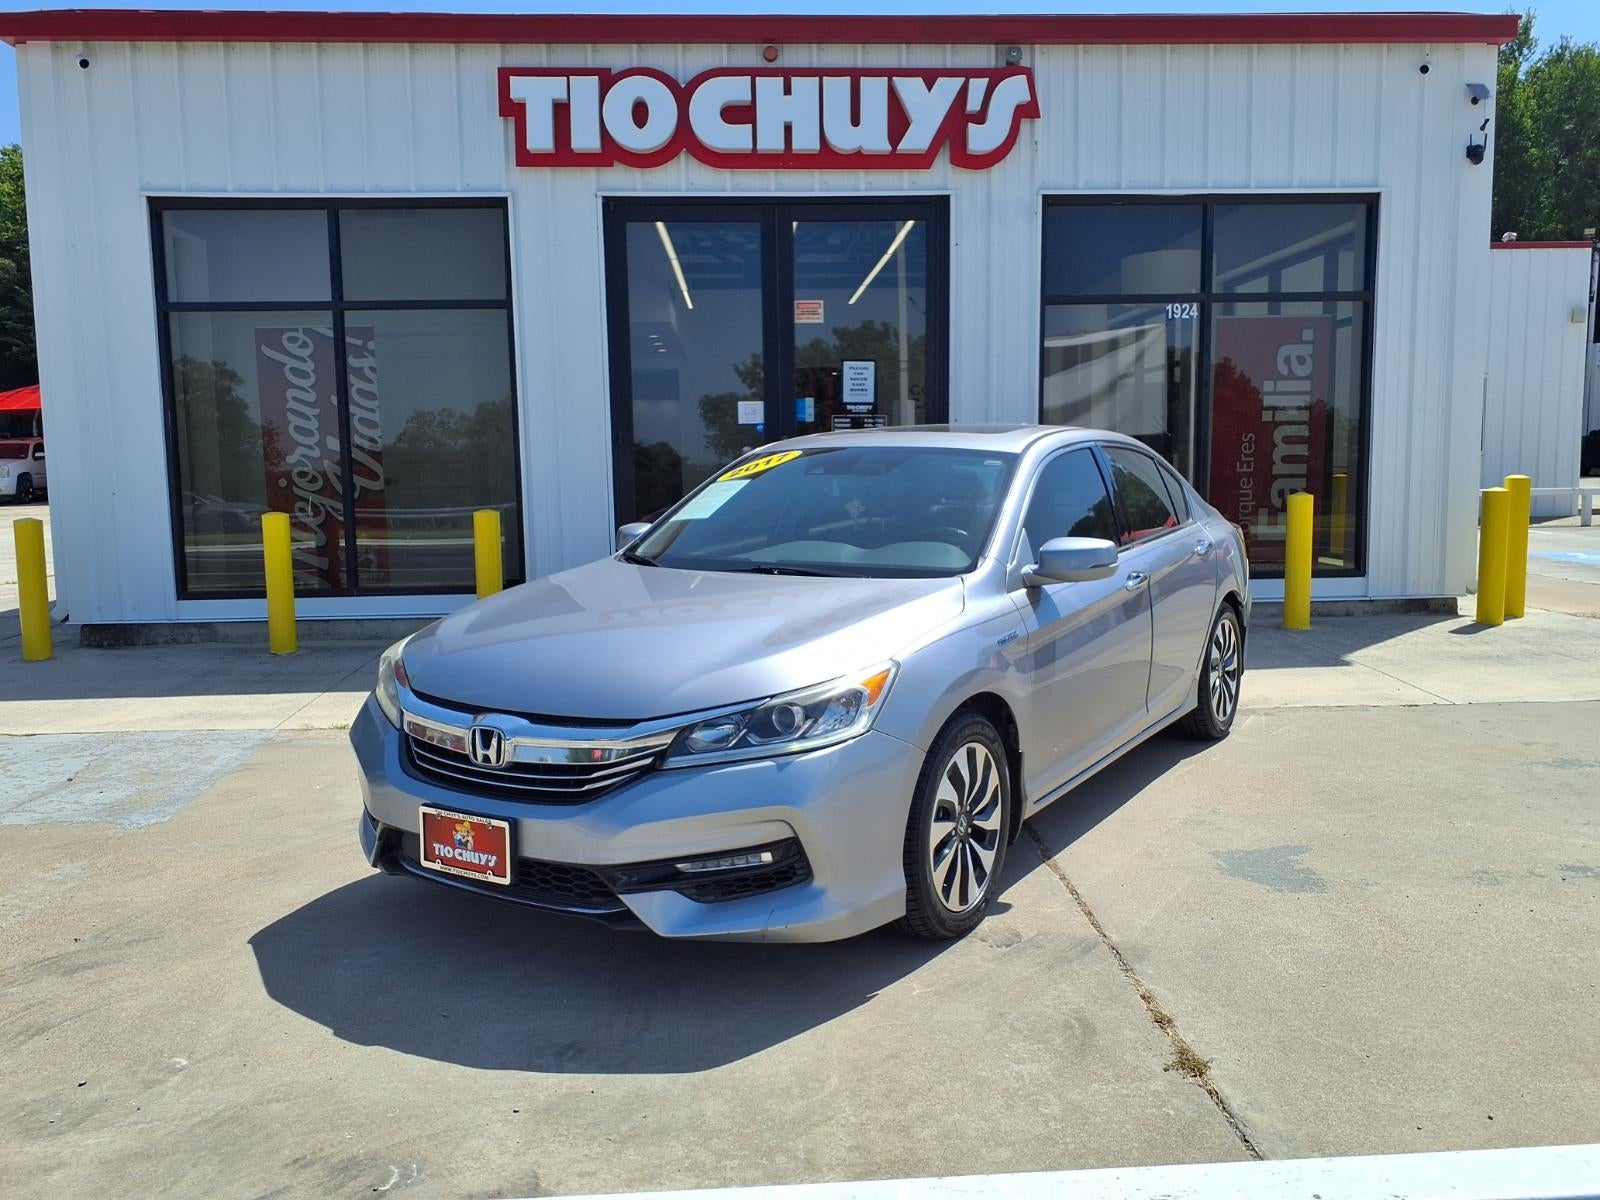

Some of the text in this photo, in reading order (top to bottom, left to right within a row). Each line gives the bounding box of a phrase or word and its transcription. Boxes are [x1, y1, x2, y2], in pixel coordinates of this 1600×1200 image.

[1165, 302, 1199, 320] 1924
[1256, 328, 1315, 541] Familia.
[730, 452, 790, 477] 2017
[1236, 432, 1256, 534] orque Eres
[432, 842, 497, 867] TIO CHUY'S
